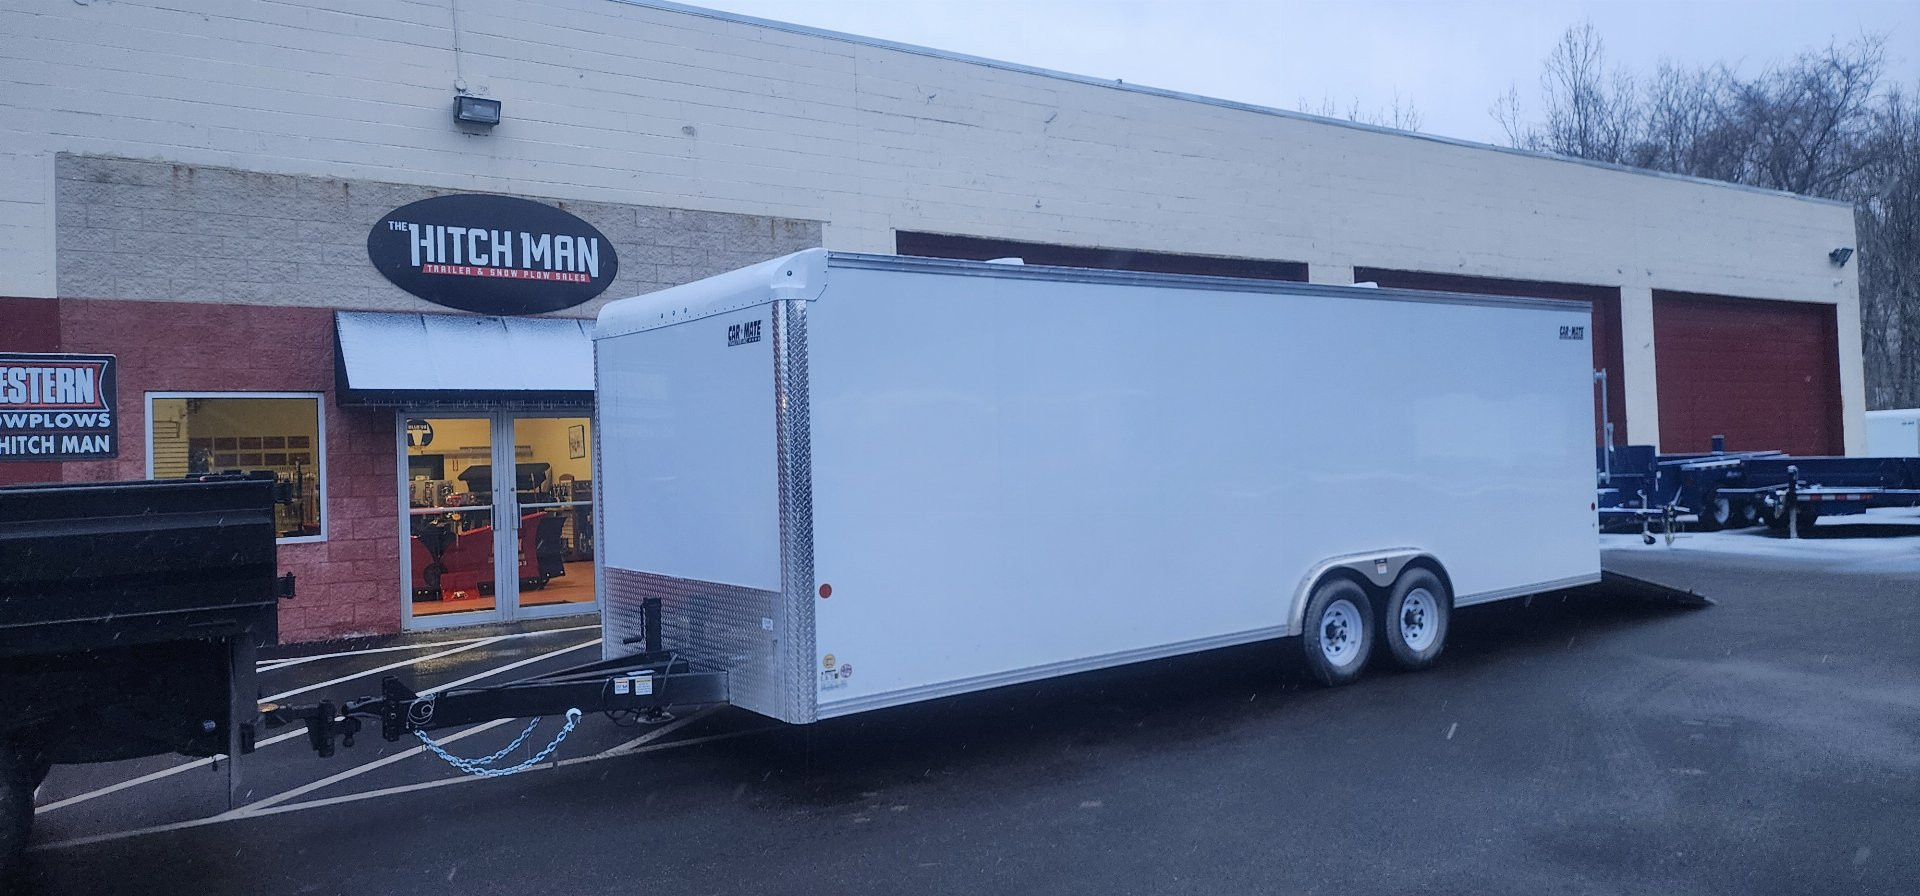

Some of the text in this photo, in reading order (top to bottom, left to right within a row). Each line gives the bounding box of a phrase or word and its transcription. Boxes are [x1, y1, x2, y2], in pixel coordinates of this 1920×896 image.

[388, 220, 599, 278] THE HITCH MAN
[427, 264, 586, 282] TRAILER & SNOW PLOW SALES
[0, 413, 111, 429] WPLOWS
[61, 435, 110, 454] MAN
